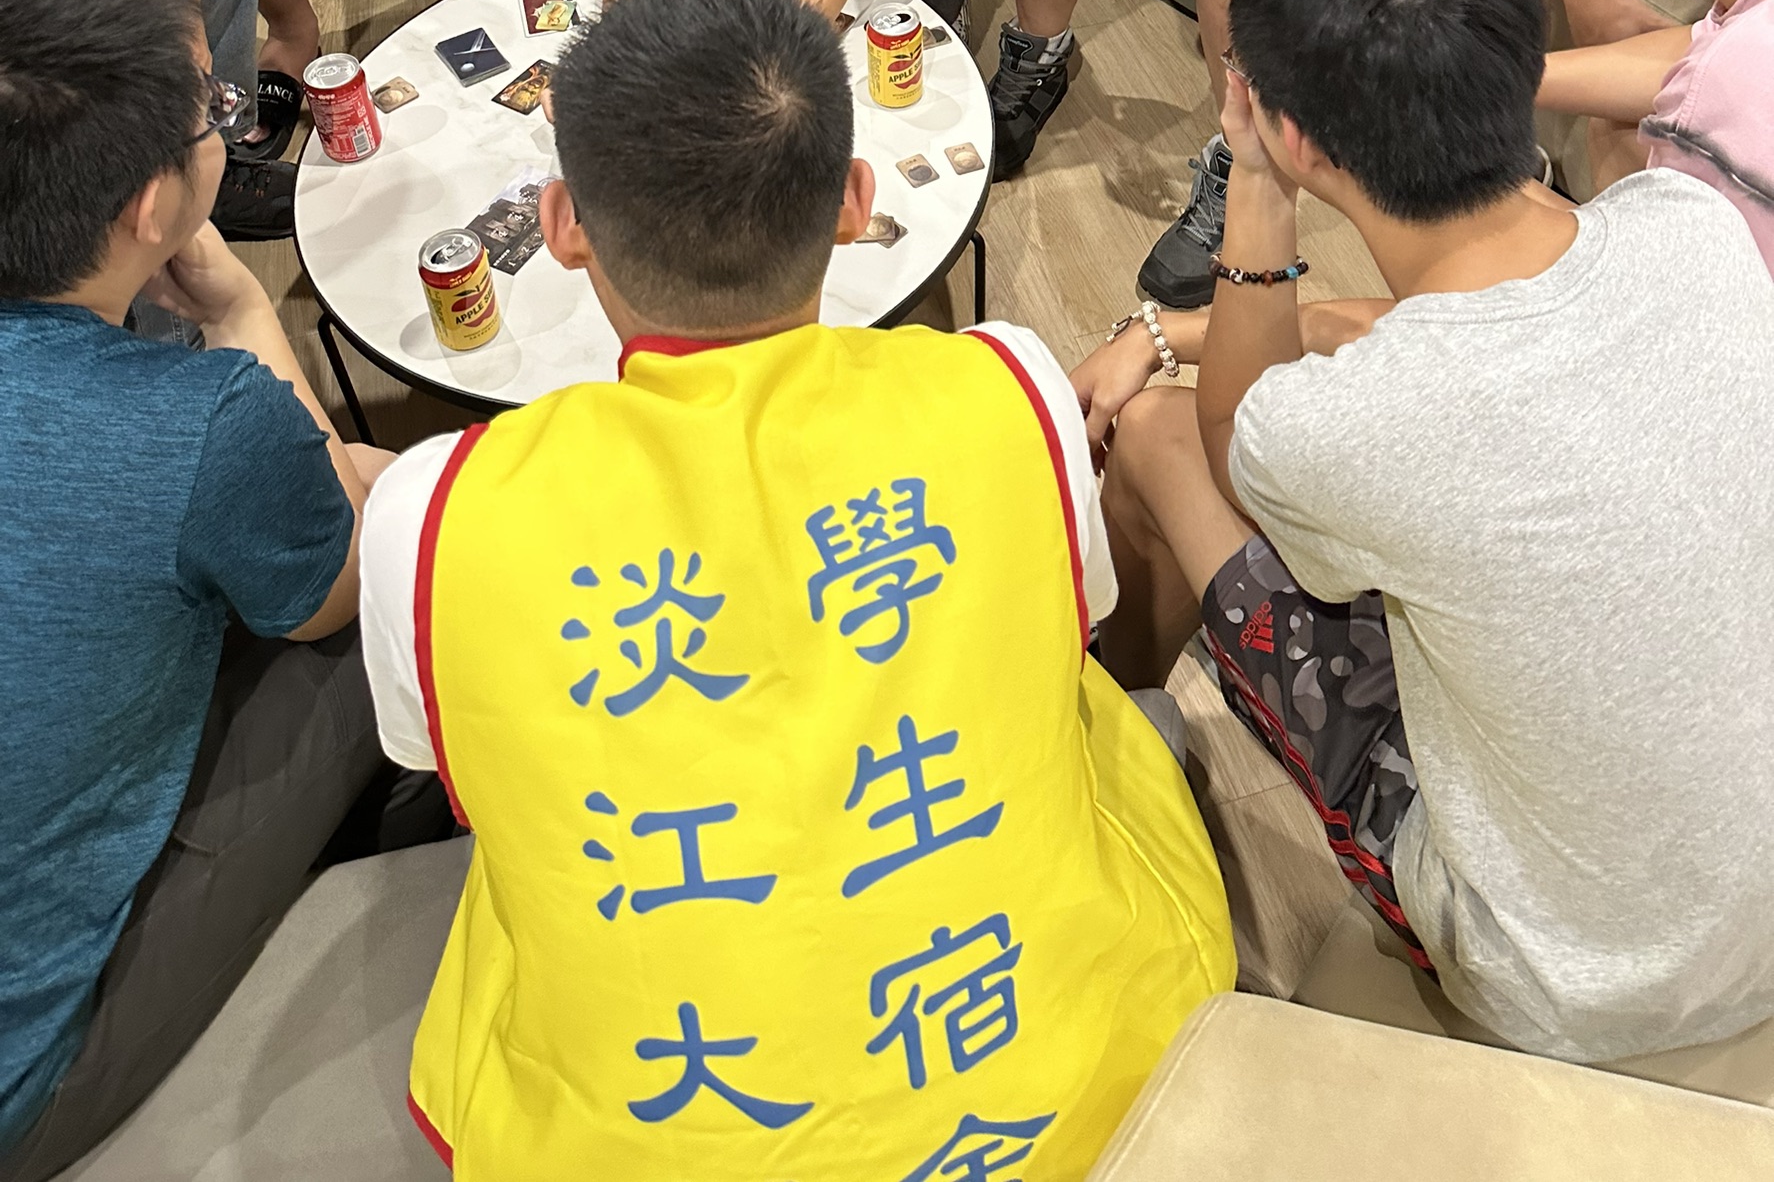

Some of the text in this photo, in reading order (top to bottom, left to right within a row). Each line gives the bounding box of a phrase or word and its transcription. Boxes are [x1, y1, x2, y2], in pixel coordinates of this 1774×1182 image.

[888, 67, 914, 84] APPLE
[454, 302, 484, 325] APPLE
[1239, 601, 1272, 650] adidas
[560, 547, 815, 1130] 淡江大
